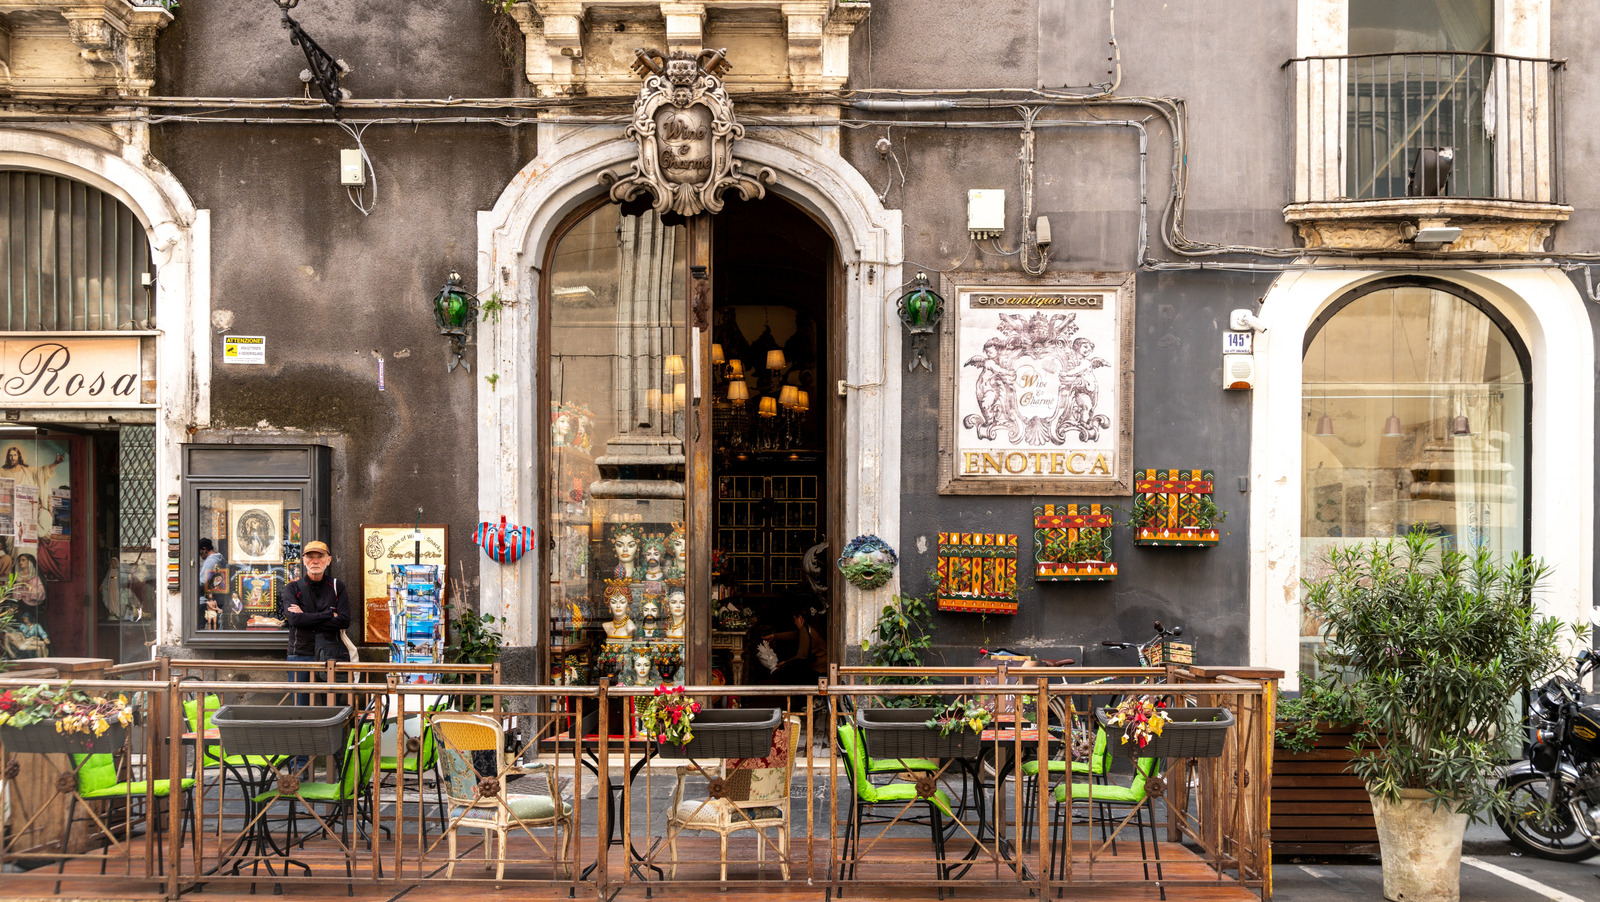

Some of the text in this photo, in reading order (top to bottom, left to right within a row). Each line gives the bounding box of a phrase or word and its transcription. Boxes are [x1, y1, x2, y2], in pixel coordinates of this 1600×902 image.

[662, 119, 706, 141] Wine
[659, 150, 712, 170] Charme
[1228, 334, 1244, 346] 145
[4, 343, 138, 396] Rosa
[1020, 374, 1048, 388] Wine
[1020, 391, 1054, 407] Charme
[963, 452, 1111, 474] ENOTECA
